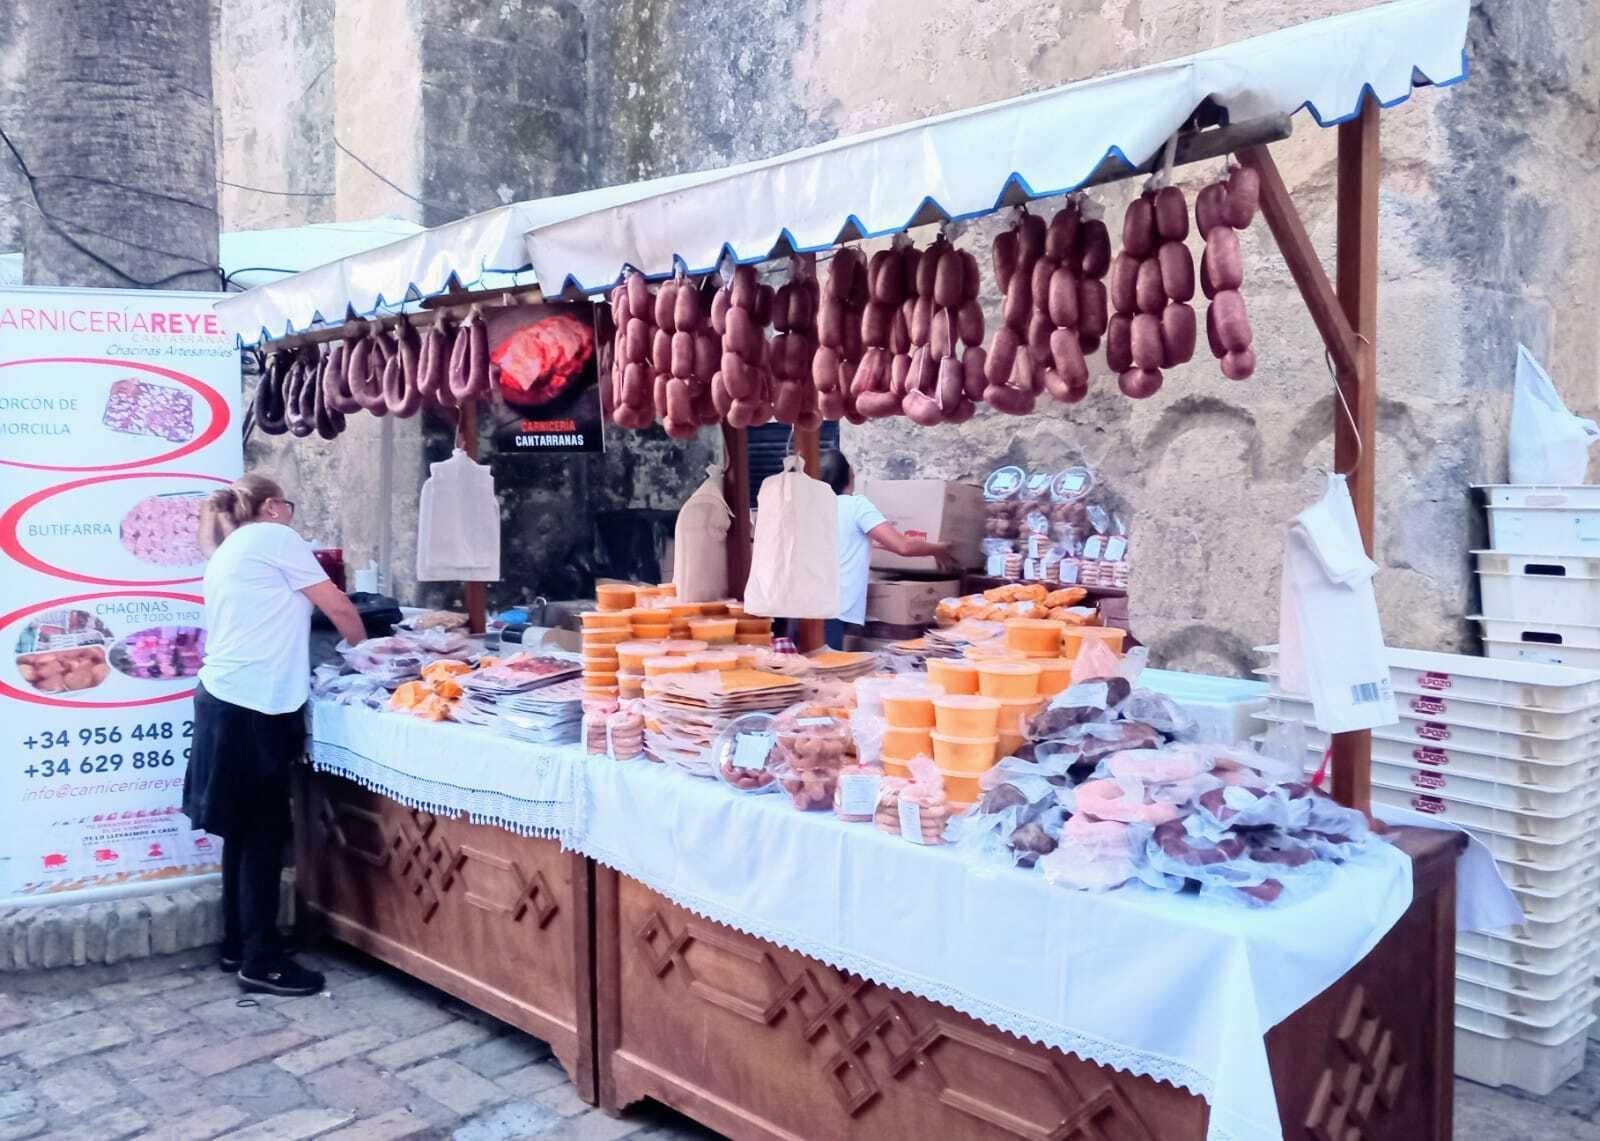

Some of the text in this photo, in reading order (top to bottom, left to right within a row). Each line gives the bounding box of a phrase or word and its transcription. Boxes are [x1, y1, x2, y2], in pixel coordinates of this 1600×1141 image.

[59, 399, 78, 411] DE
[515, 434, 584, 447] CANTARRANAS
[28, 523, 113, 537] BUTIFARRA
[95, 601, 169, 616] CHACINAS
[126, 615, 141, 624] DE
[176, 611, 200, 622] TIPO
[23, 730, 70, 750] +34
[78, 726, 122, 746] 956
[131, 722, 173, 741] 448
[23, 758, 71, 778] +34
[79, 754, 123, 774] 629
[132, 749, 175, 769] 886
[22, 777, 184, 802] info@carniceriareye
